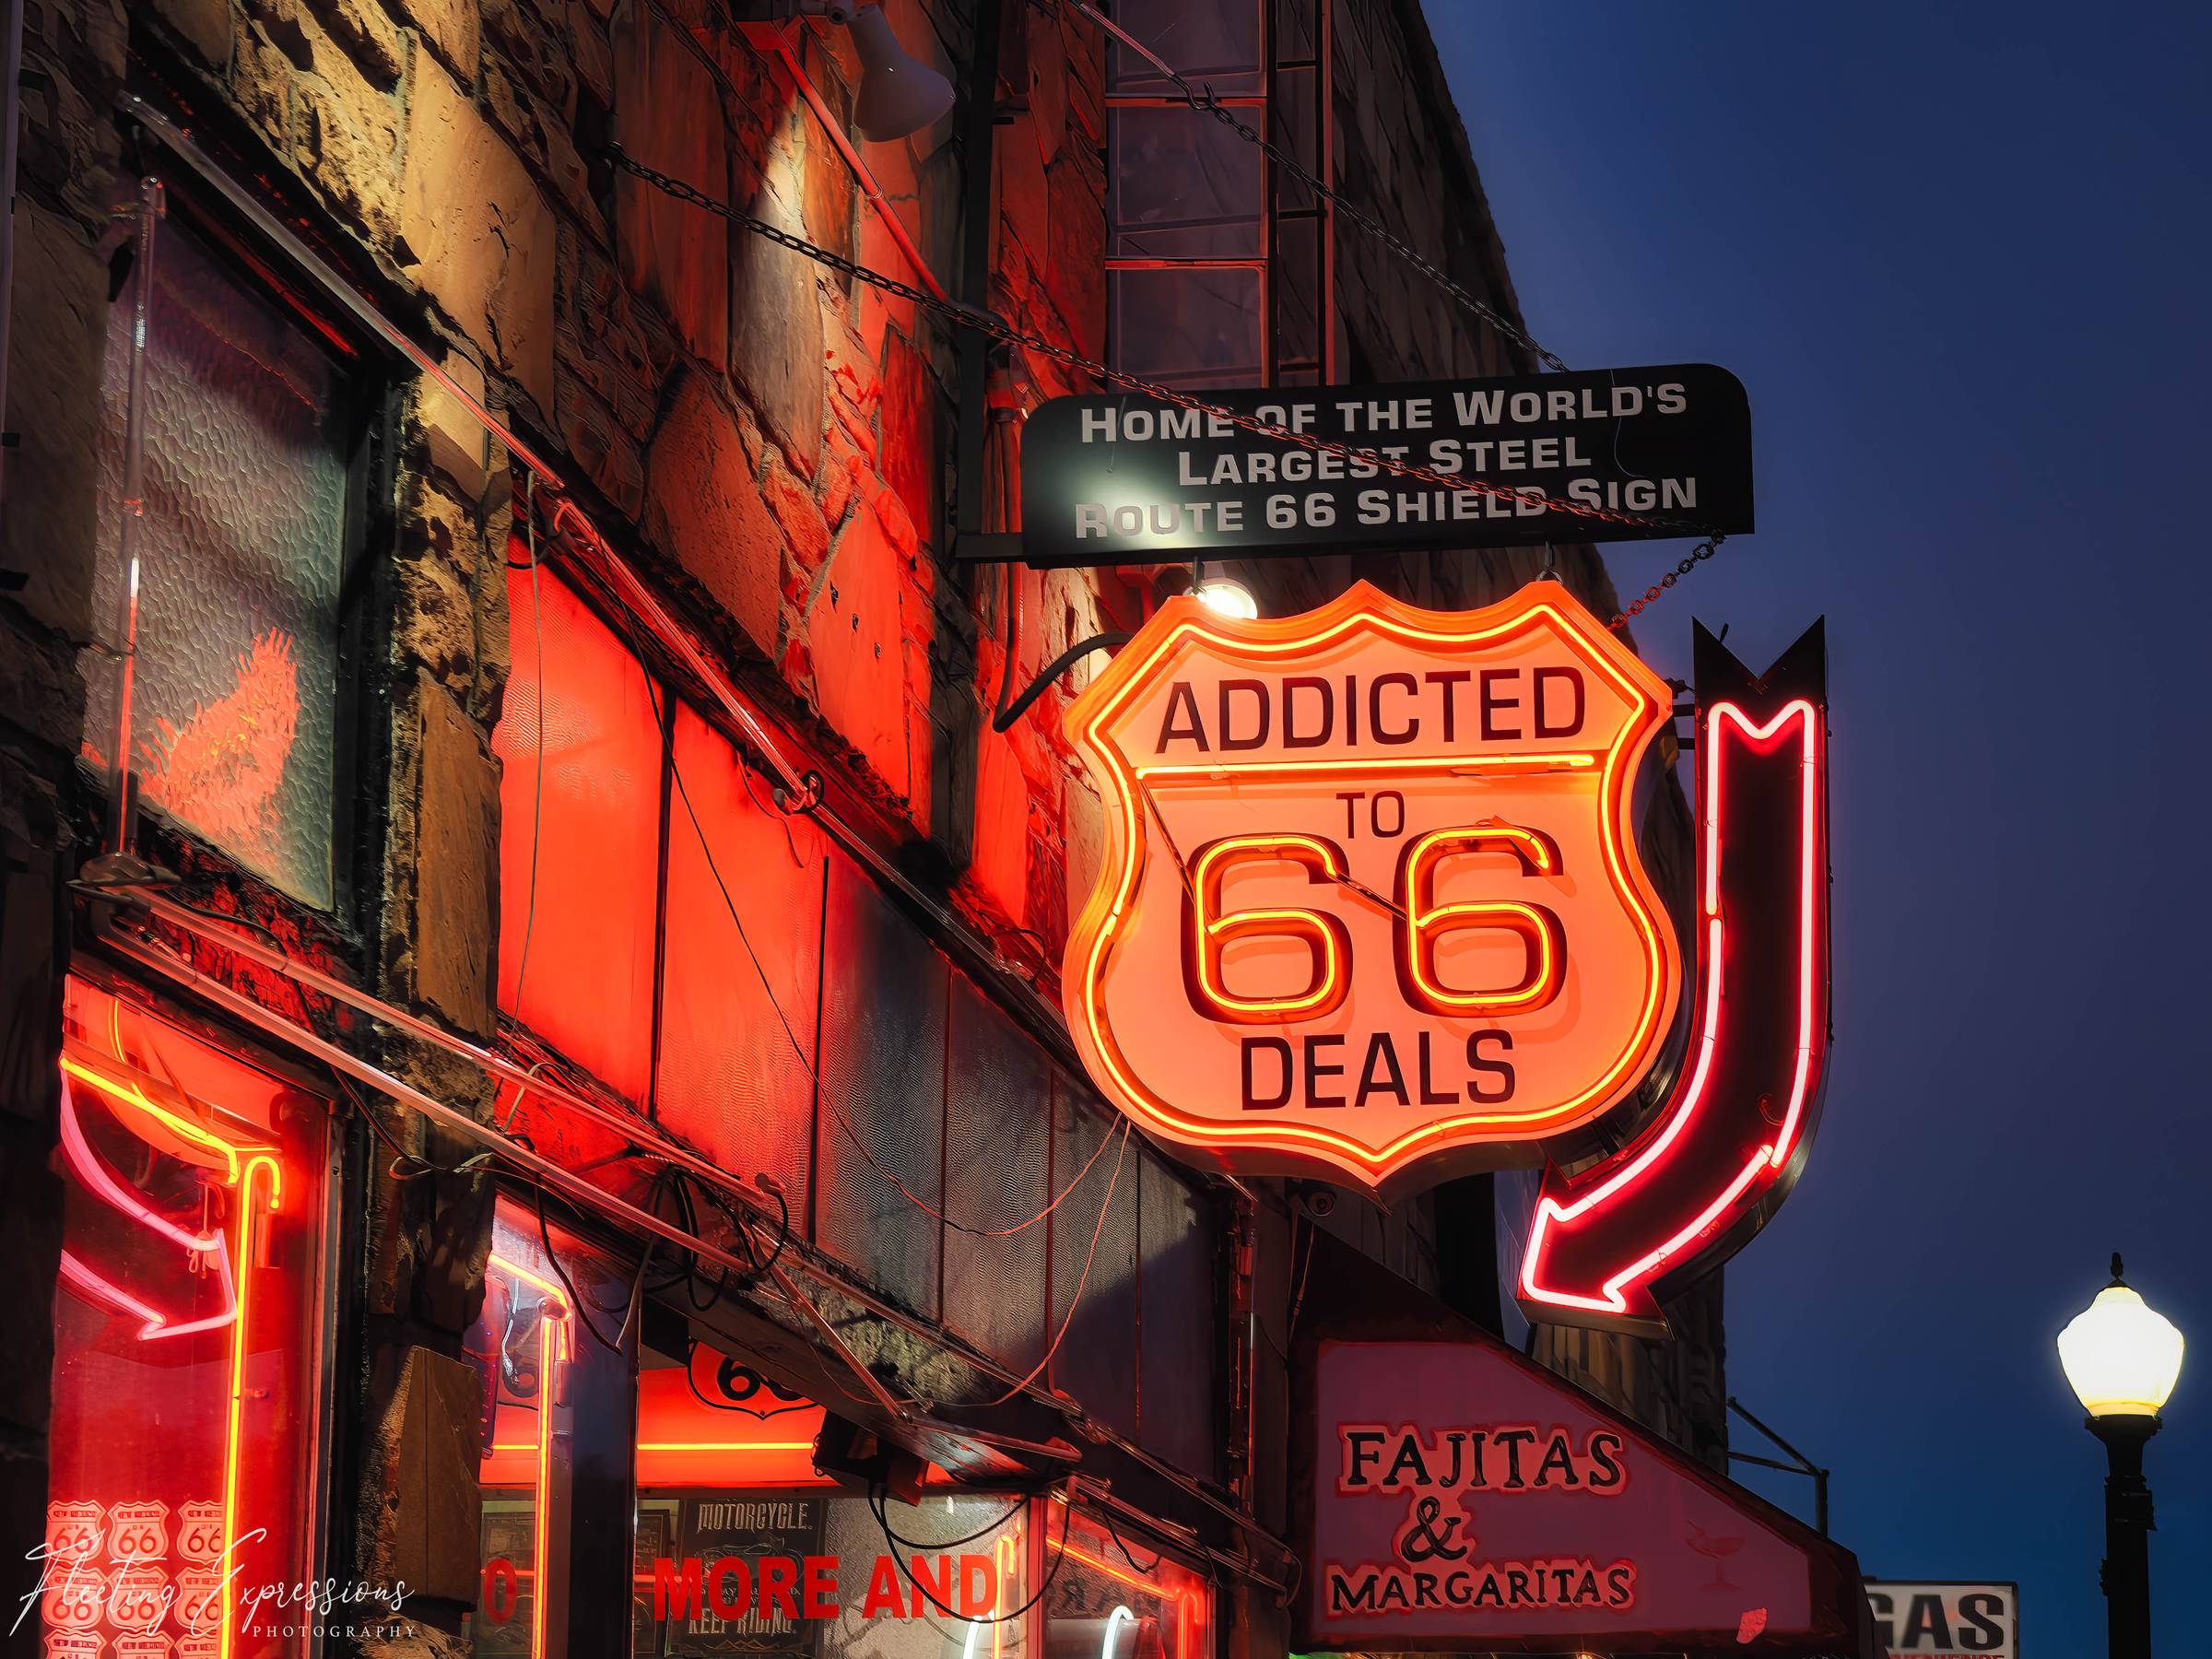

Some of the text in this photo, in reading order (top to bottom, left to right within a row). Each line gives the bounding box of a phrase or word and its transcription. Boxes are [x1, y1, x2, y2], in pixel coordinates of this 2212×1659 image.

[1335, 397, 1433, 431] THE
[1429, 436, 1592, 475] STEEL
[1265, 492, 1336, 529] 66
[1154, 665, 1586, 755] ADDICTED
[1335, 790, 1406, 840] TO
[1181, 826, 1568, 1026] 66
[1241, 1029, 1517, 1112] DEALS
[717, 1357, 805, 1402] 6
[1346, 1430, 1624, 1489] FAJITAS
[53, 1527, 93, 1554] 66
[118, 1527, 157, 1555] 66
[187, 1527, 221, 1554] 66
[1400, 1496, 1468, 1562] &
[53, 1594, 93, 1621] 66
[117, 1594, 156, 1621] 66
[653, 1555, 841, 1622] MORE
[861, 1554, 999, 1619] AND
[1330, 1568, 1631, 1611] MARGARITAS
